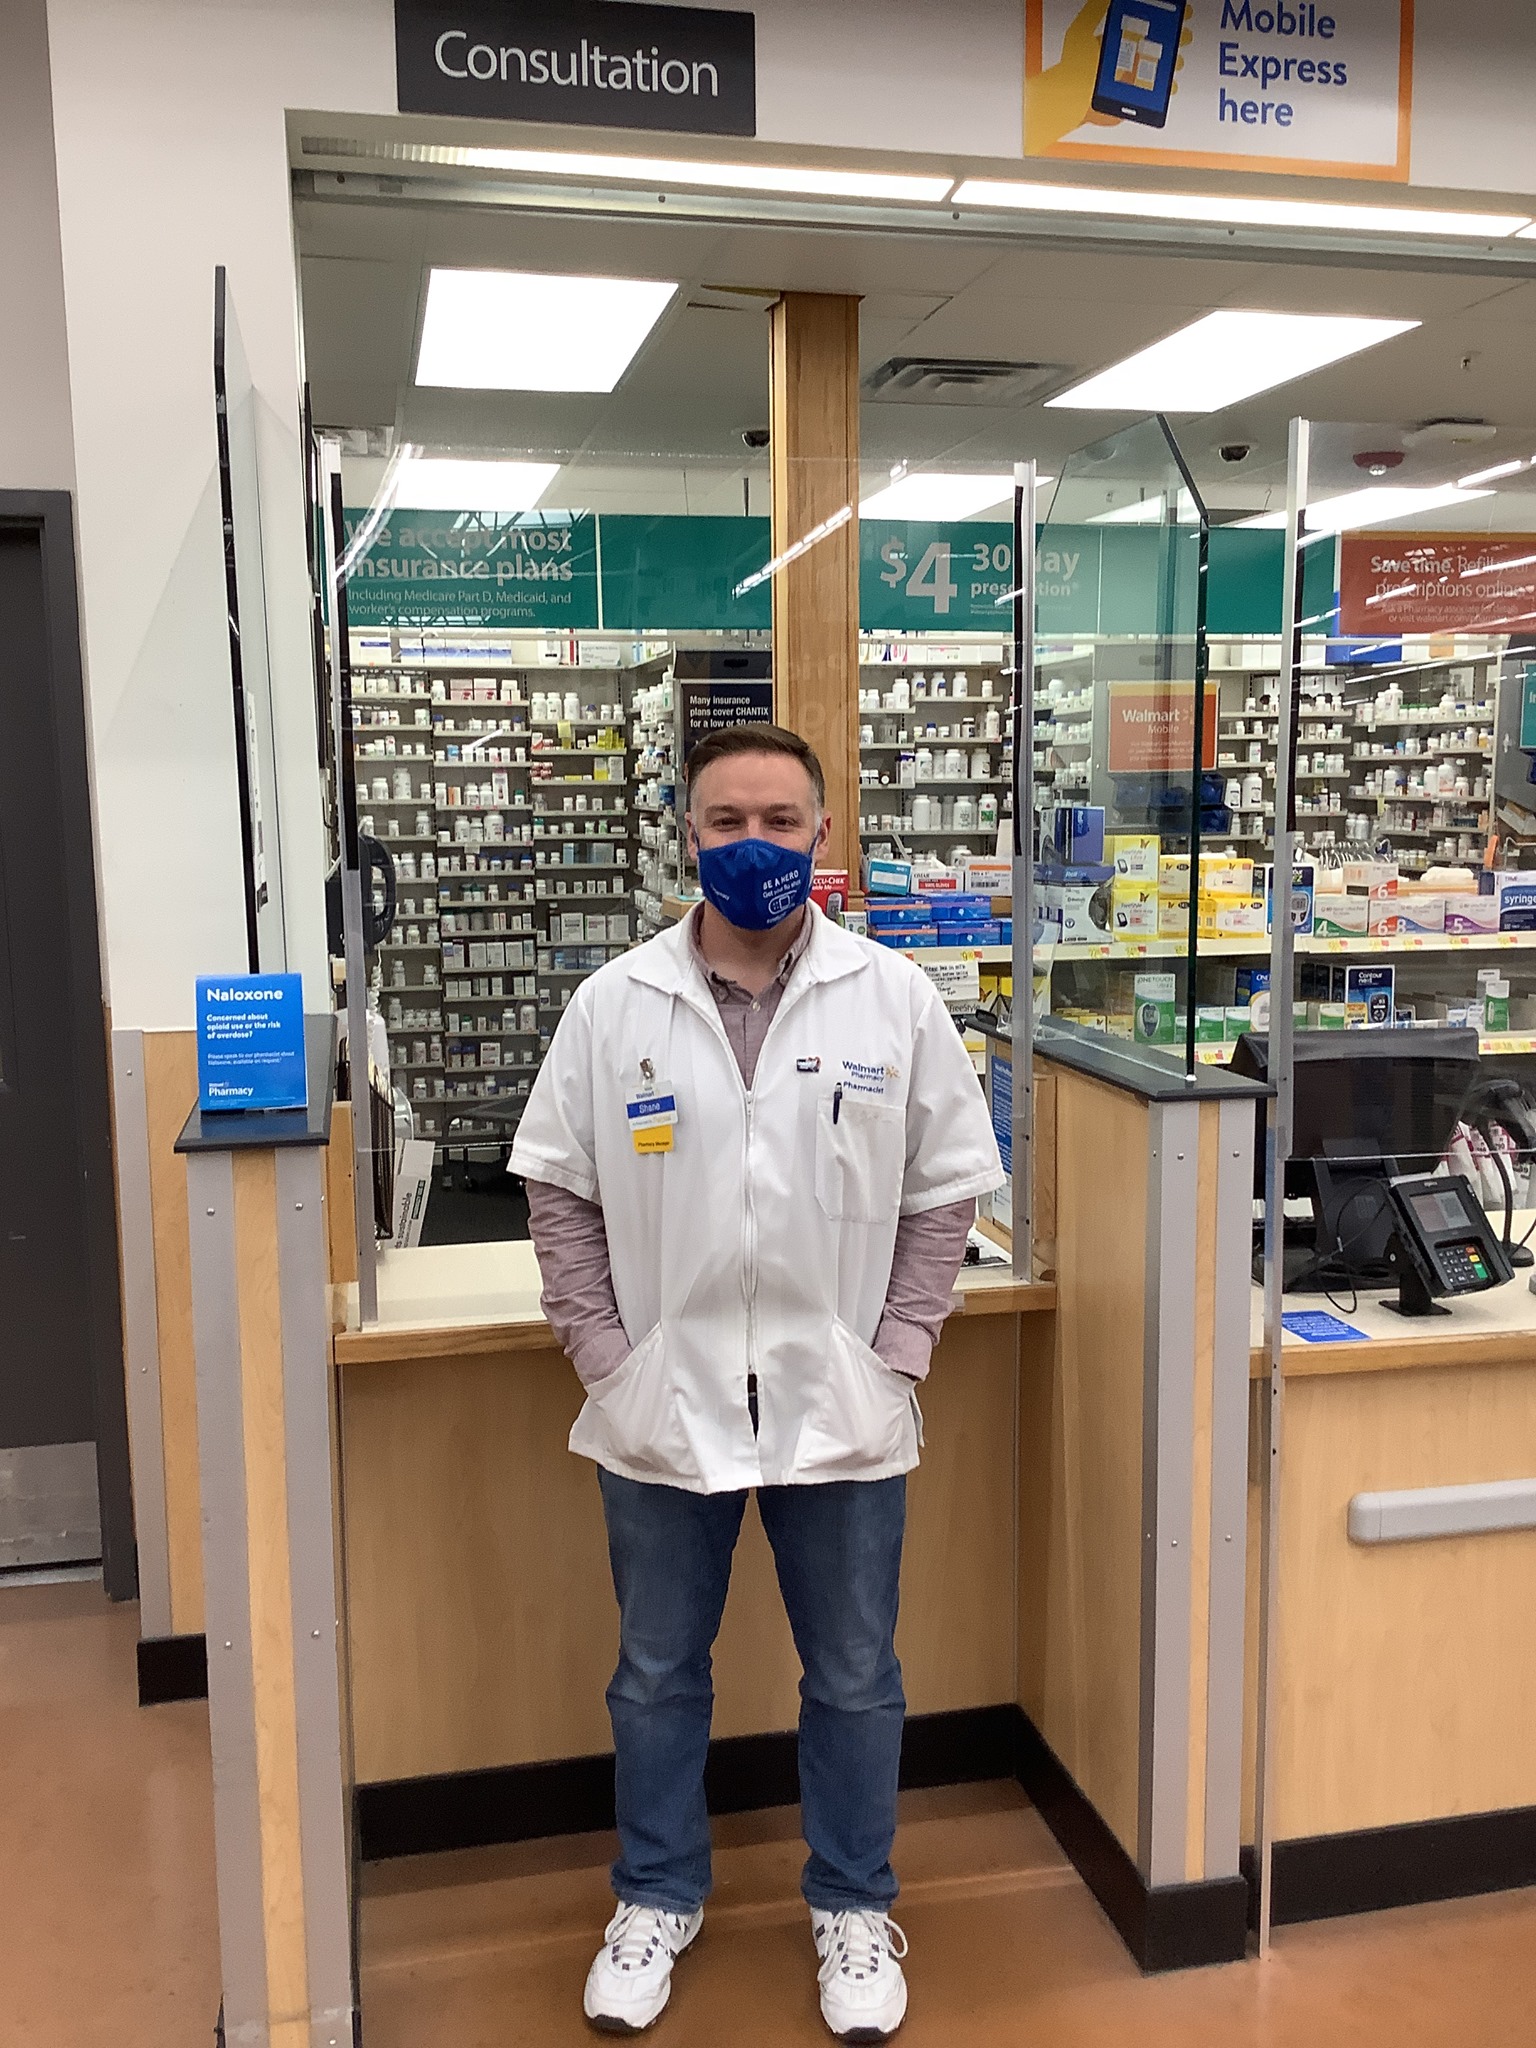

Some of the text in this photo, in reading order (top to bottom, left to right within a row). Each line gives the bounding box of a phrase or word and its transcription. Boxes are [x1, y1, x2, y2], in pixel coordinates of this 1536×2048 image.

[1220, 0, 1336, 39] Mobile
[434, 30, 719, 97] Consultation
[1218, 42, 1348, 89] Express
[1218, 89, 1295, 127] here
[399, 525, 496, 555] accept
[501, 527, 572, 551] most
[351, 555, 573, 585] nsurance plans
[1371, 556, 1410, 573] Save
[1413, 557, 1455, 573] time.
[1458, 555, 1494, 572] Refill
[880, 536, 958, 614] $4
[1376, 579, 1472, 600] prescriptions
[349, 589, 571, 604] Including Medicare Part D, Medicaid, and
[398, 605, 479, 617] compensation
[481, 606, 535, 618] programs.
[1404, 605, 1442, 615] Pharmacy
[690, 696, 711, 706] Many
[690, 708, 711, 717] plans
[736, 707, 768, 716] CHANTIX
[1122, 709, 1180, 722] Walmart
[690, 719, 700, 727] for
[710, 719, 724, 728] low
[1148, 724, 1179, 734] Mobile
[763, 870, 798, 890] BE A HERO
[812, 876, 846, 885] CCU-CHEK
[1378, 884, 1388, 899] 6
[1317, 920, 1328, 937] 4
[1378, 920, 1388, 936] 6
[1397, 919, 1406, 933] 8
[1454, 918, 1463, 933] 5
[207, 989, 283, 1001] Naloxone
[949, 1004, 981, 1013] FreeStyle
[207, 1014, 246, 1022] Concerned
[207, 1023, 229, 1032] opioid
[217, 1031, 252, 1039] overdose?
[842, 1061, 884, 1074] Walmart
[851, 1071, 884, 1083] Pharmacy
[208, 1088, 254, 1096] Pharmacy
[843, 1081, 884, 1094] Pharmacist
[639, 1102, 660, 1113] Shane
